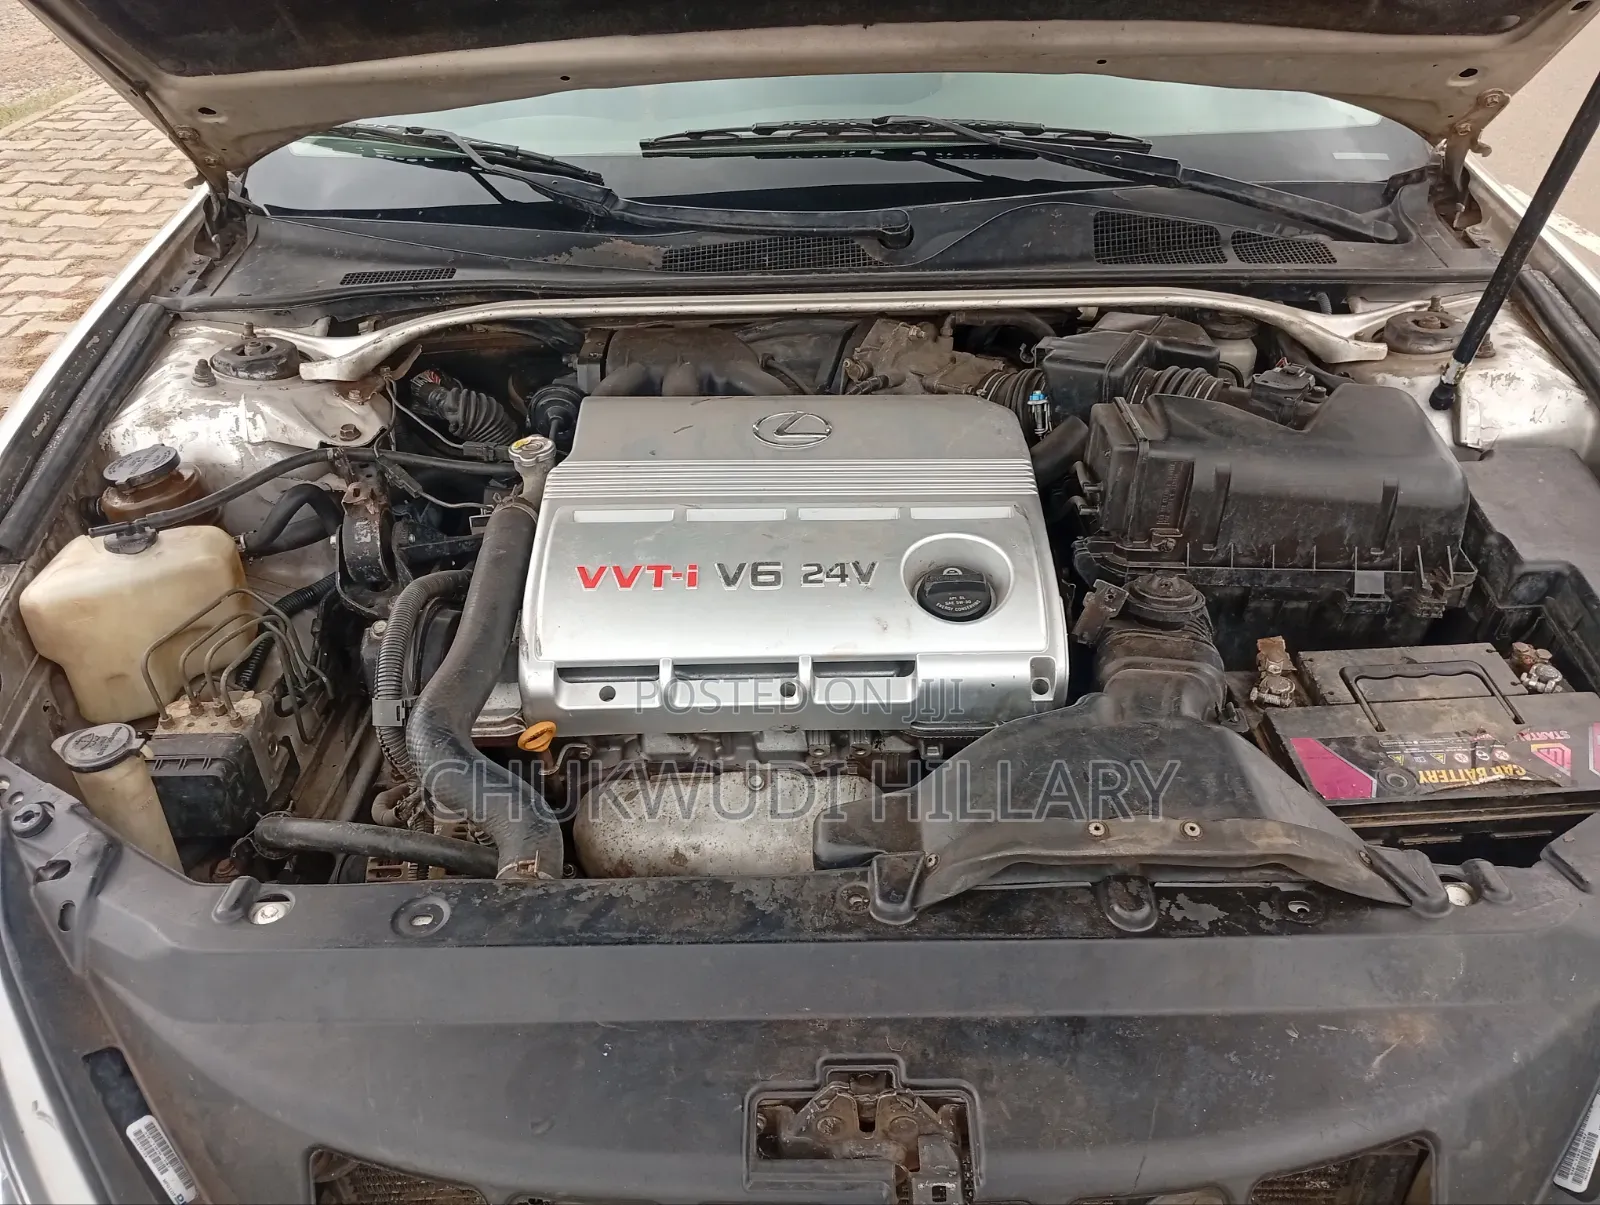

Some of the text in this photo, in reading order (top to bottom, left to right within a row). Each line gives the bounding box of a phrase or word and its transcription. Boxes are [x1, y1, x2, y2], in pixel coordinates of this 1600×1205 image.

[576, 560, 880, 591] VVT-i V6 24V
[936, 602, 954, 611] ENERGY
[1419, 767, 1487, 783] BATTERY
